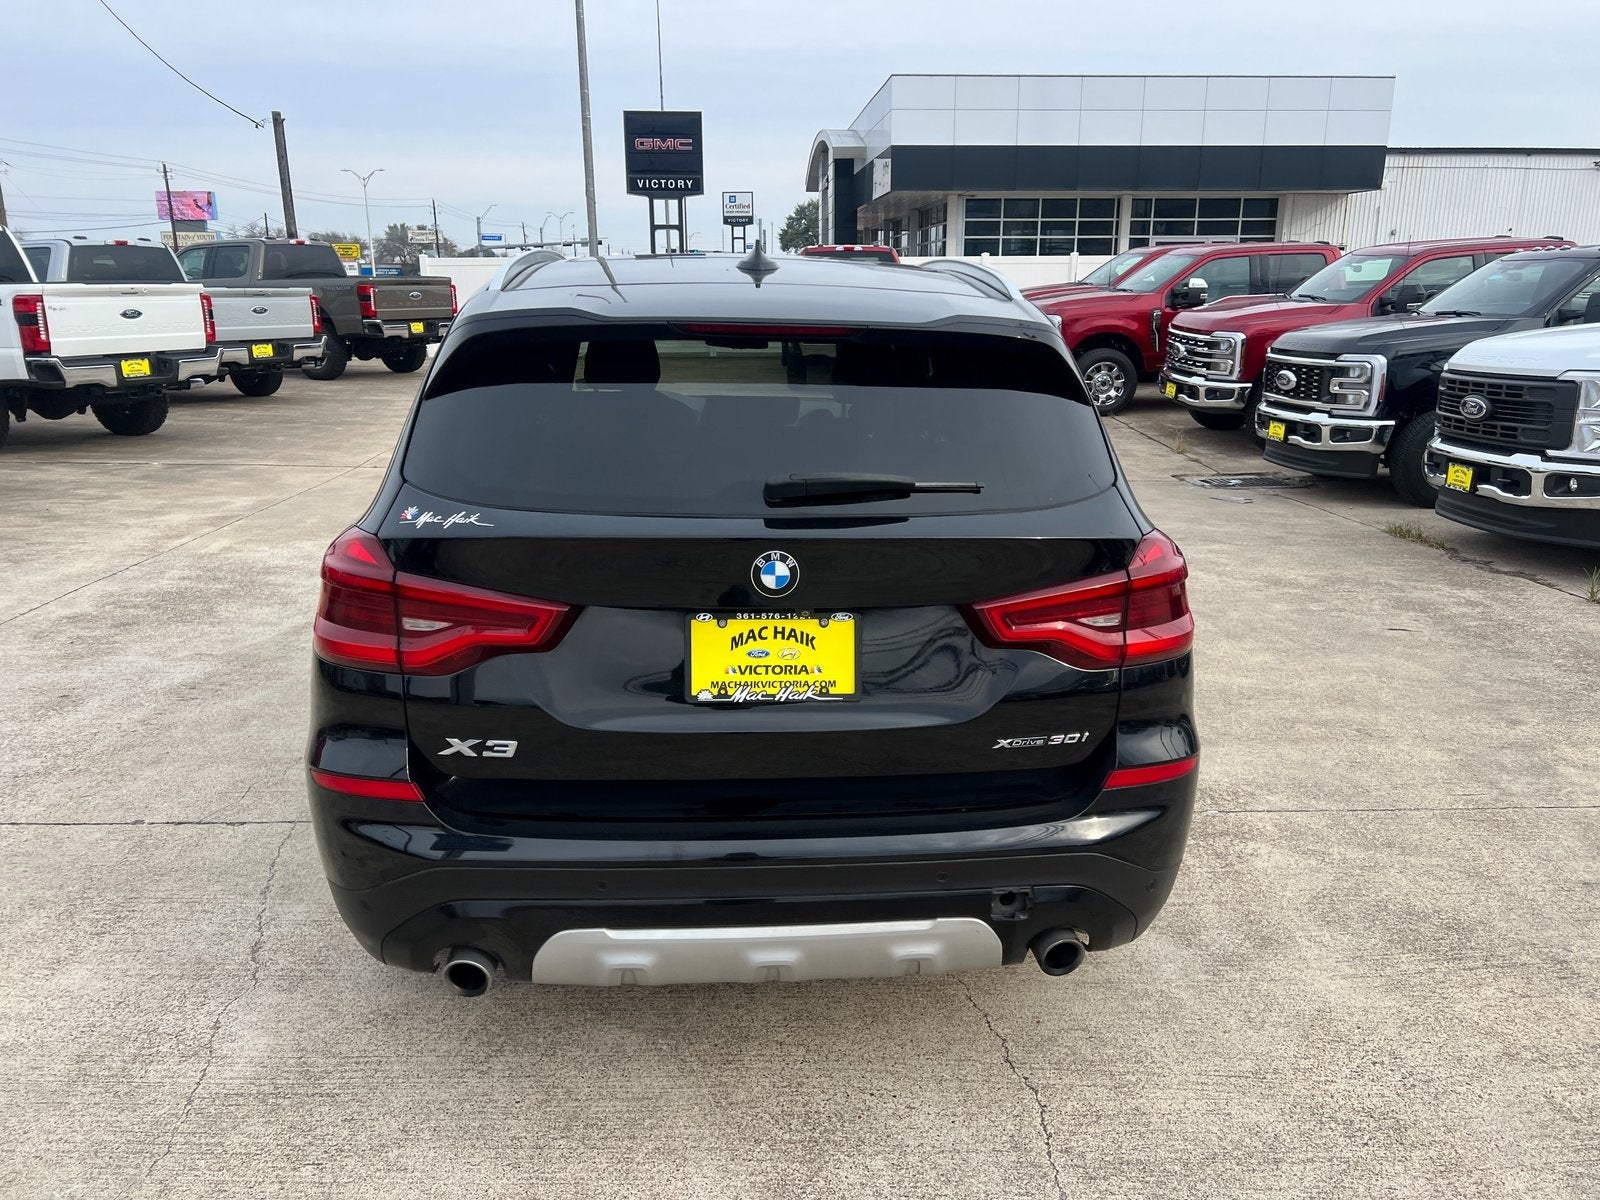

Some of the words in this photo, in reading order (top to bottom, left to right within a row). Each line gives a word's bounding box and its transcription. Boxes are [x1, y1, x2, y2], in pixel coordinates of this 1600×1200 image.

[634, 138, 693, 151] GMC
[637, 179, 693, 189] VICTORY
[414, 511, 444, 529] Mac
[442, 511, 486, 529] Haik
[755, 552, 796, 568] BMW
[736, 612, 811, 620] 361-576-12
[730, 626, 769, 651] MAC
[773, 626, 817, 651] HAIK
[748, 649, 768, 658] Ford
[738, 664, 810, 675] VICTORIA
[730, 685, 773, 702] Mac
[774, 684, 826, 702] Haik
[1048, 731, 1090, 745] 30i
[437, 737, 519, 758] X3
